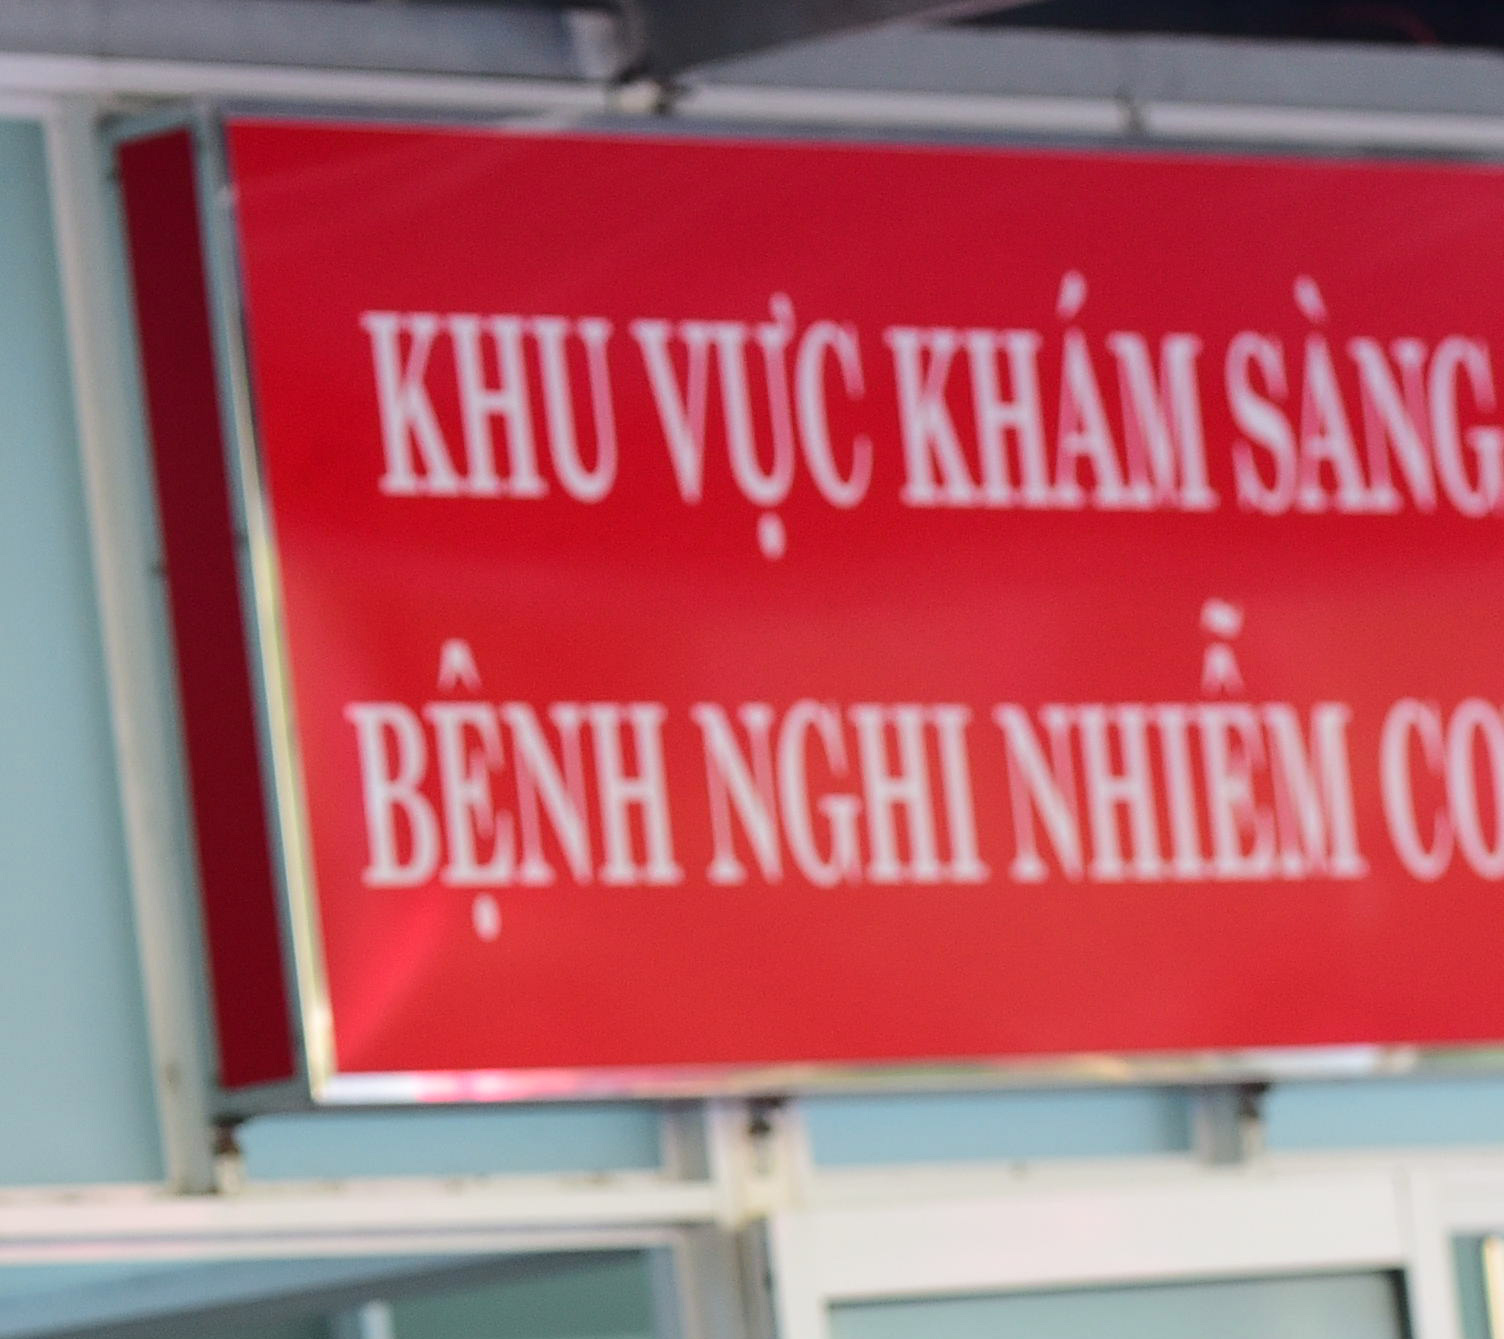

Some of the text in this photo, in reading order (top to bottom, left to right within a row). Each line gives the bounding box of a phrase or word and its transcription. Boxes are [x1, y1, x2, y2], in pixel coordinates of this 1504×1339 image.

[363, 311, 616, 501] KHU
[632, 292, 872, 560] VỰC
[885, 274, 1217, 512] KHÁM
[350, 638, 686, 940] BỆNH
[693, 700, 990, 887] NGHI
[995, 600, 1370, 885] NHIỄM
